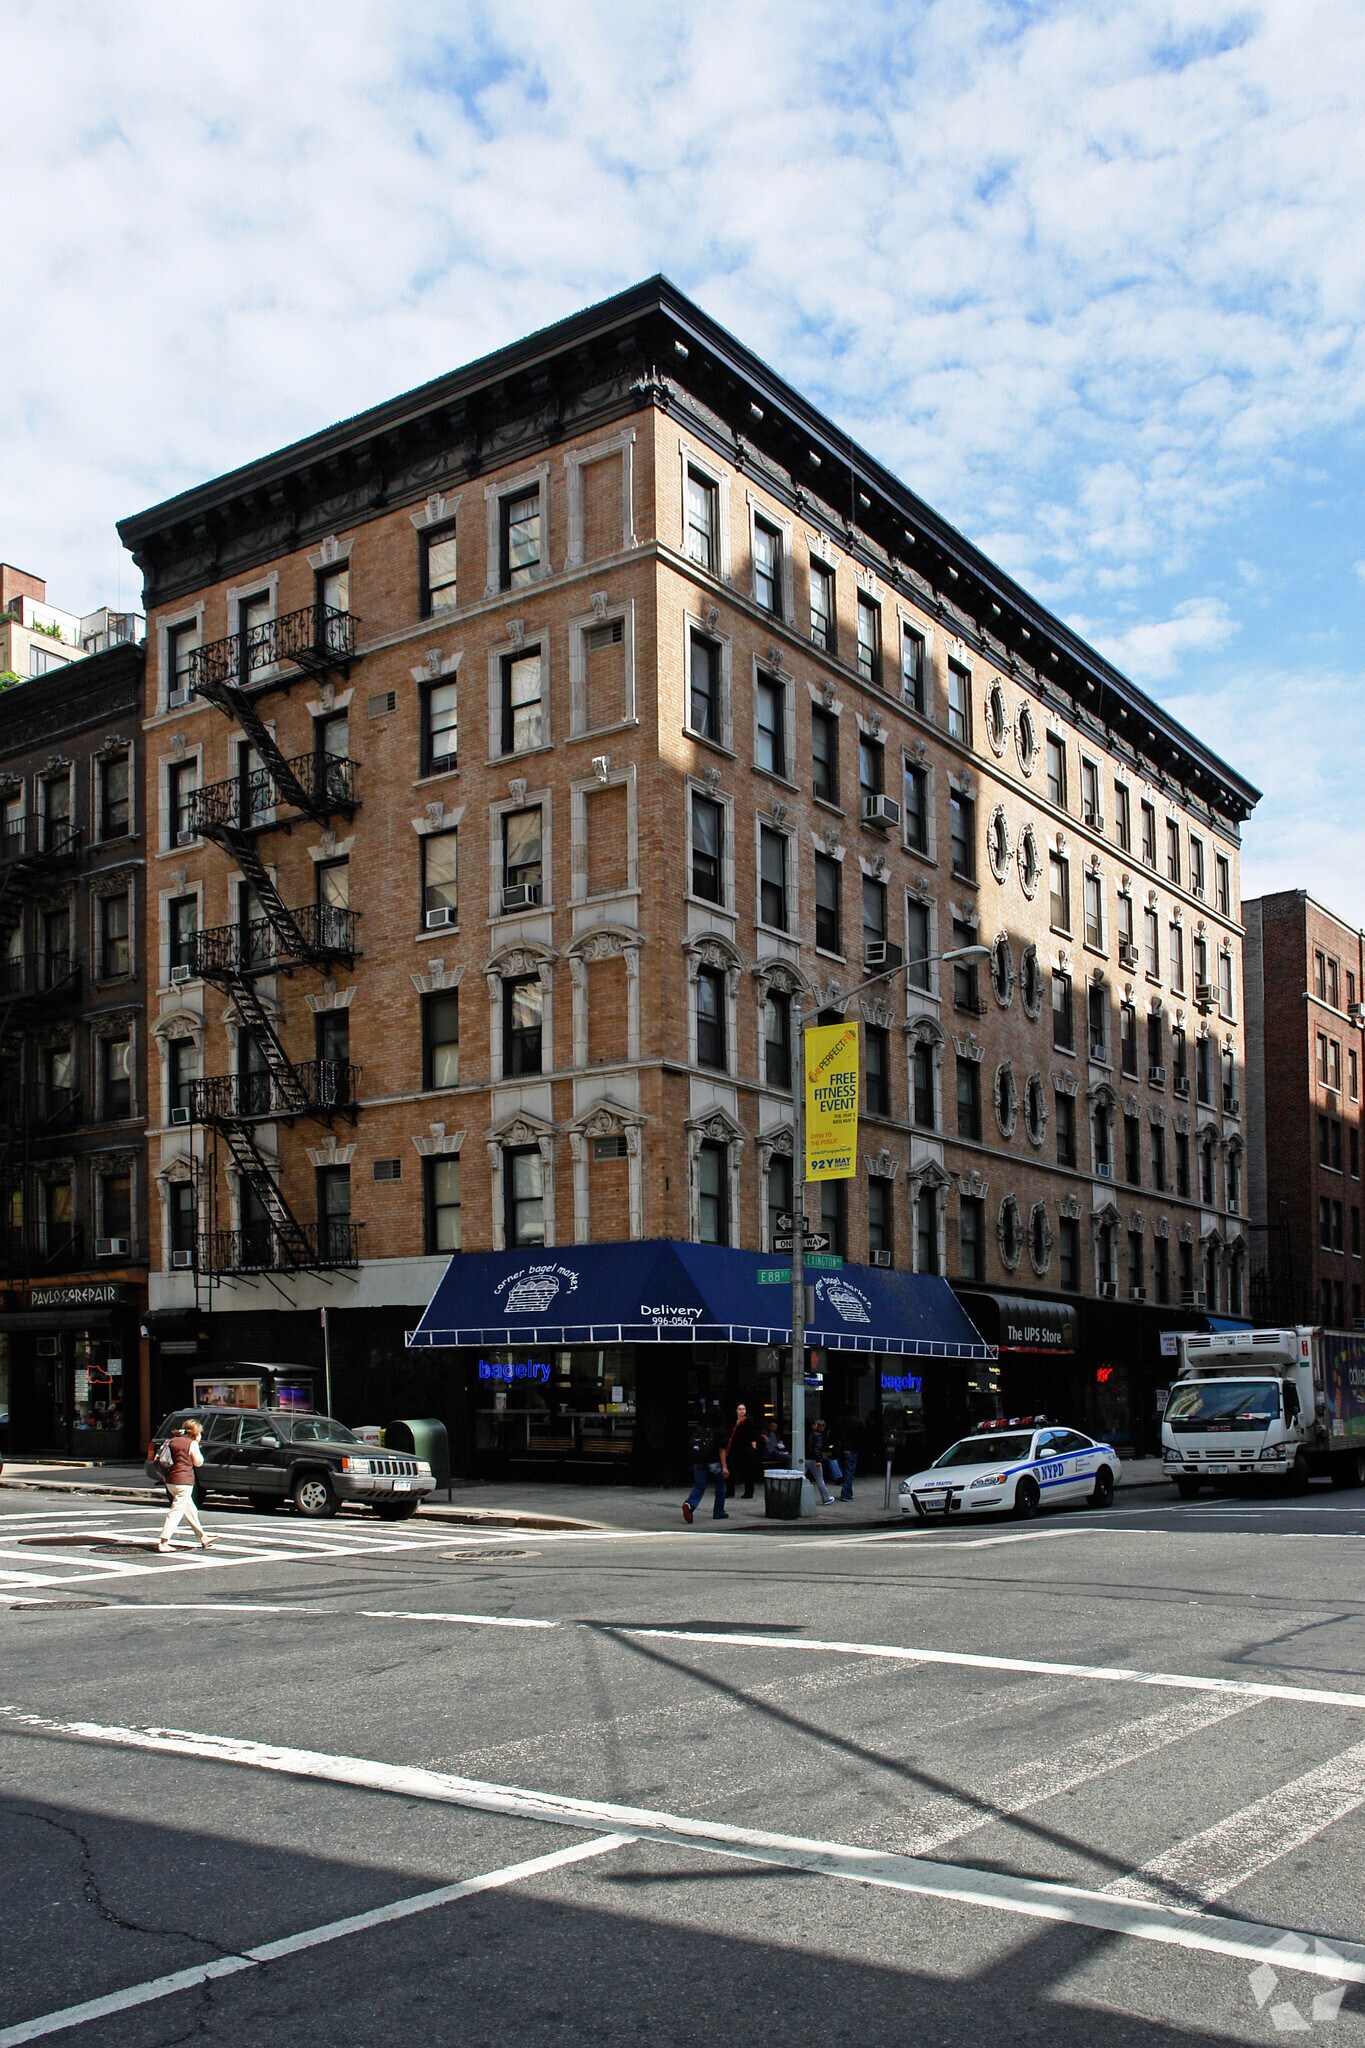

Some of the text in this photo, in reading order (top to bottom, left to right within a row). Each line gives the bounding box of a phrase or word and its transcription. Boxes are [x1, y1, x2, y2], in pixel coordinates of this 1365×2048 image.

[830, 1072, 856, 1085] FREE
[814, 1085, 856, 1100] FITNESS
[820, 1098, 856, 1112] EVENT
[810, 1132, 825, 1140] OPEN
[820, 1138, 838, 1146] PUBLIC
[494, 1262, 580, 1295] corner bagel market
[761, 1272, 767, 1282] E
[768, 1271, 780, 1282] 88
[75, 1286, 116, 1303] REPAIR
[640, 1304, 703, 1319] Delivery
[652, 1316, 694, 1326] 996-0567
[1008, 1325, 1023, 1341] The
[1024, 1326, 1040, 1342] UPS
[1042, 1328, 1062, 1343] Store
[478, 1358, 552, 1383] bagelry
[881, 1371, 922, 1393] bagelry
[1041, 1463, 1065, 1480] NYPD
